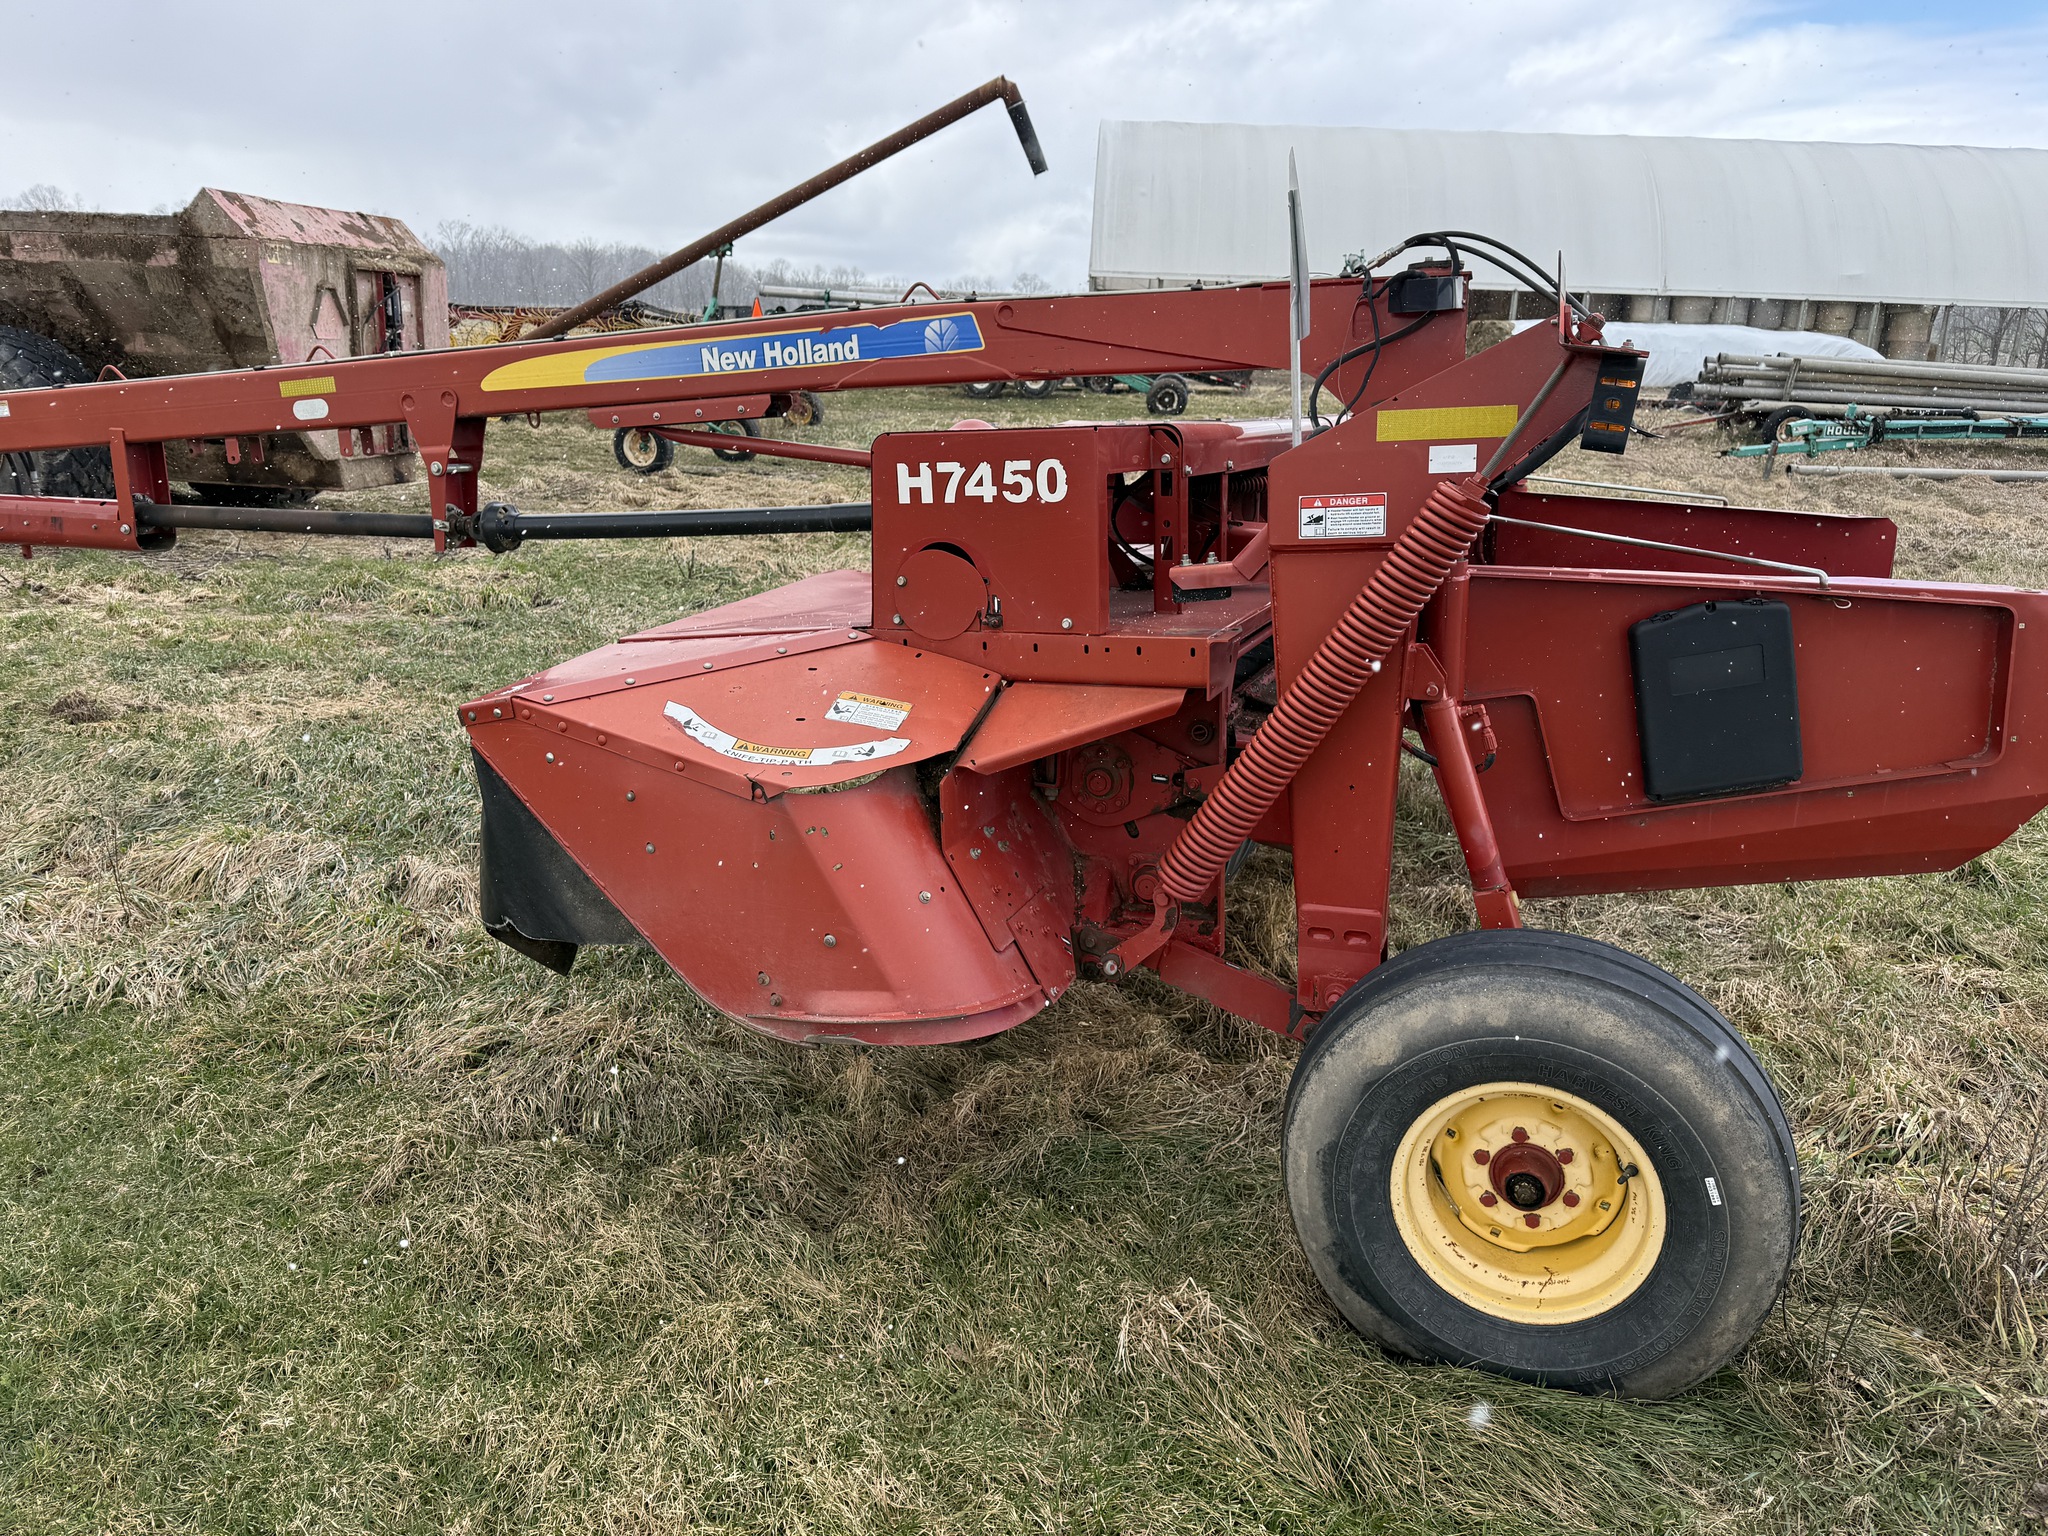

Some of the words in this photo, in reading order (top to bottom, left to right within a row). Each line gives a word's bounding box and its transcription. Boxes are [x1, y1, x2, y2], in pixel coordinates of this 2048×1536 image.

[700, 347, 756, 372] New
[763, 334, 860, 367] Holland
[896, 458, 1068, 504] H7450
[1329, 497, 1368, 506] DANGER
[752, 745, 807, 758] WARNING
[1369, 1045, 1469, 1114] PROTECTION
[1538, 1063, 1645, 1120] HARVEST
[1642, 1124, 1683, 1172] KING
[1685, 1229, 1727, 1317] SIDEWALL
[1577, 1322, 1690, 1384] PROTECTION
